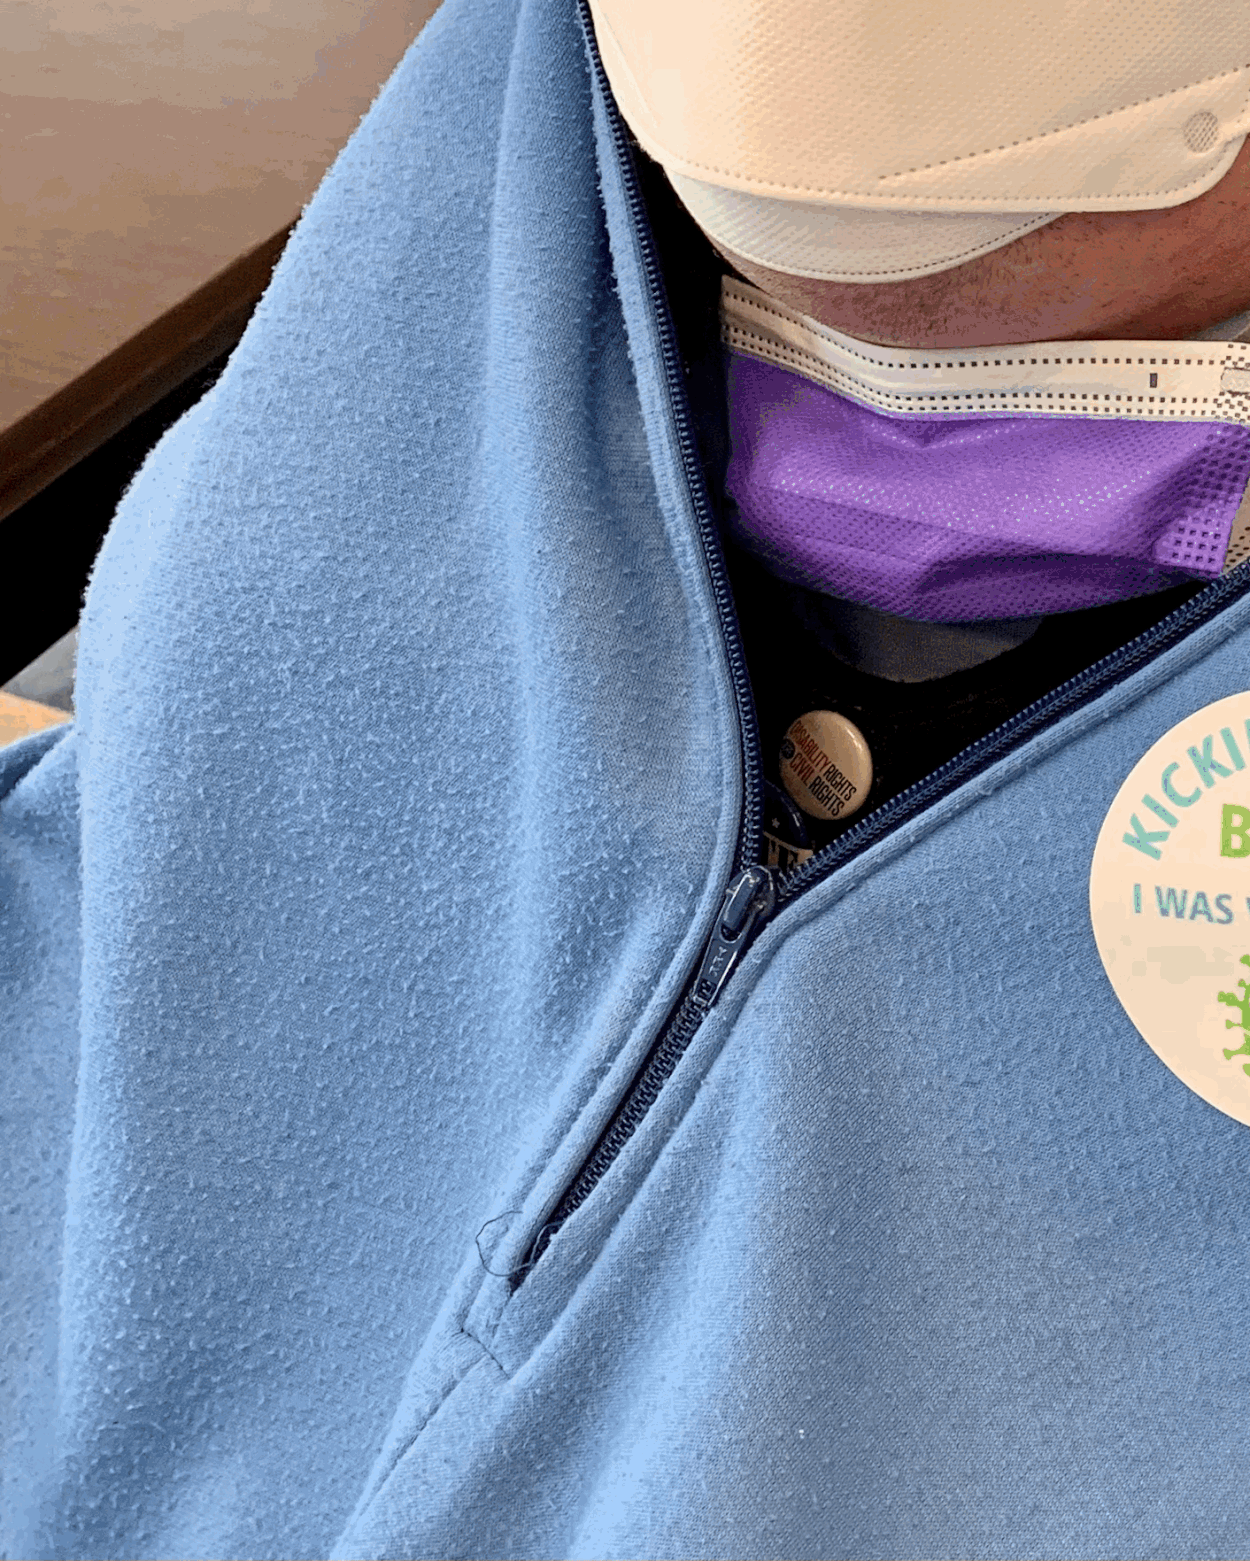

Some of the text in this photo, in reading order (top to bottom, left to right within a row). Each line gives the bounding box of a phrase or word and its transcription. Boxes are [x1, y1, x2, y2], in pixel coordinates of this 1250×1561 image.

[789, 720, 857, 801] DISABILITY RIGHTS
[790, 752, 845, 816] CIVIL RIGHTS
[1133, 883, 1142, 913] I
[1155, 885, 1234, 925] WAS
